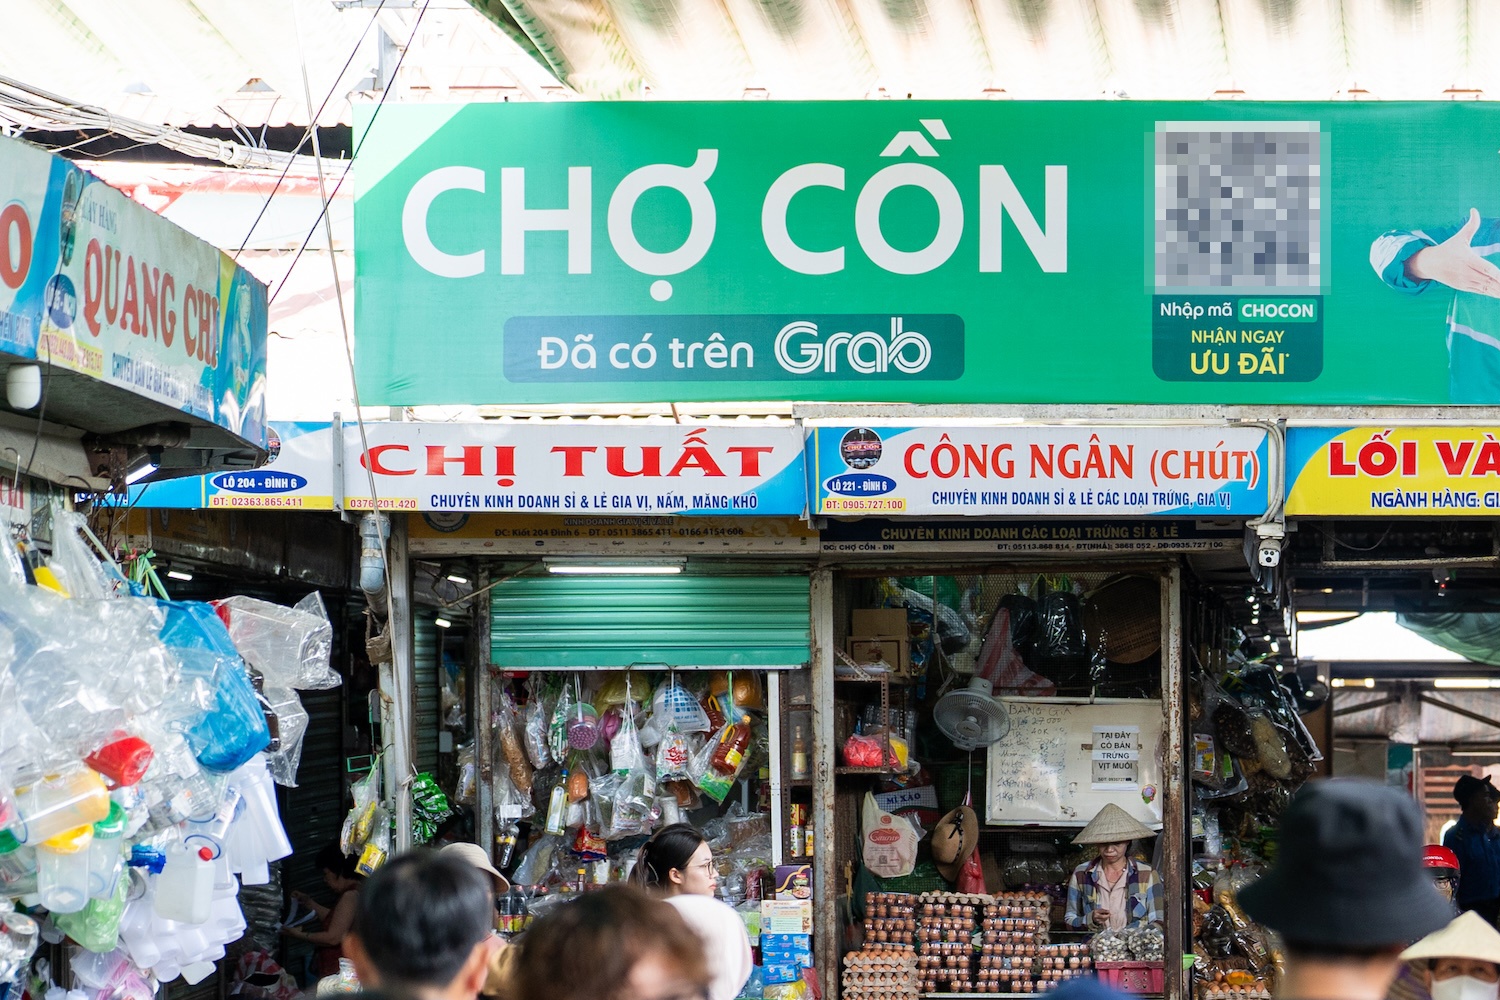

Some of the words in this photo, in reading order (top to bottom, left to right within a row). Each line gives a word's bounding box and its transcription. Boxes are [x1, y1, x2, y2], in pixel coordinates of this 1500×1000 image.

[401, 149, 719, 301] CHỢ
[761, 119, 1068, 275] CỒN
[83, 238, 177, 348] QUANG
[1159, 301, 1204, 321] Nhập
[1207, 303, 1233, 317] mã
[1241, 303, 1314, 318] CHOCON
[537, 331, 597, 370] Đã
[610, 332, 657, 369] có
[668, 333, 753, 370] trên
[774, 317, 932, 374] Grab
[1191, 326, 1236, 347] NHẬN
[1241, 330, 1285, 345] NGAY
[1190, 350, 1230, 375] ƯU
[359, 445, 517, 487] CHỊ
[550, 428, 774, 478] TUẤT
[904, 433, 1015, 479] CÔNG
[1030, 433, 1134, 480] NGÂN
[1150, 440, 1260, 488] (CHÚT)
[1329, 429, 1417, 476] LỐI
[223, 476, 236, 488] LÔ
[237, 478, 255, 488] 204
[264, 476, 289, 488] ĐÌNH
[290, 479, 297, 488] 6
[832, 478, 842, 491] LÔ
[843, 481, 855, 491] 221
[863, 478, 881, 491] ĐÌNH
[882, 481, 887, 491] 6
[213, 498, 229, 506] ĐT:
[232, 498, 303, 506] 02363.865.411
[431, 491, 480, 508] CHUYÊN
[484, 494, 513, 508] KINH
[518, 495, 560, 508] DOANH
[564, 491, 576, 508] SỈ
[580, 495, 589, 508] &
[594, 491, 607, 508] LẺ
[612, 495, 632, 508] GIA
[636, 495, 652, 511] VỊ,
[657, 490, 688, 511] NẤM,
[692, 492, 728, 508] MĂNG
[732, 492, 757, 508] KHÔ
[826, 500, 840, 509] ĐT:
[843, 500, 903, 509] 0905.727.100
[932, 488, 977, 505] CHUYÊN
[981, 491, 1007, 505] KINH
[1012, 491, 1050, 505] DOANH
[1054, 488, 1064, 505] SỈ
[1068, 492, 1076, 505] &
[1081, 488, 1093, 505] LẺ
[1097, 488, 1119, 506] CÁC
[1124, 492, 1149, 508] LOẠI
[1153, 488, 1193, 507] TRỨNG,
[1197, 492, 1216, 506] GIA
[1219, 492, 1230, 510] VỊ
[1371, 488, 1427, 508] NGÀNH
[1432, 488, 1480, 508] HÀNG:
[532, 529, 548, 537] 204
[574, 529, 579, 537] 6
[881, 525, 935, 540] CHUYÊN
[938, 528, 970, 540] KINH
[974, 527, 1018, 540] DOANH
[1024, 525, 1048, 540] CÁC
[1052, 527, 1081, 541] LOẠI
[1085, 525, 1129, 539] TRỨNG
[1149, 527, 1158, 538] &
[1101, 732, 1113, 740] TẠI
[1102, 751, 1130, 759] TRỨNG
[1098, 762, 1110, 770] VỊT
